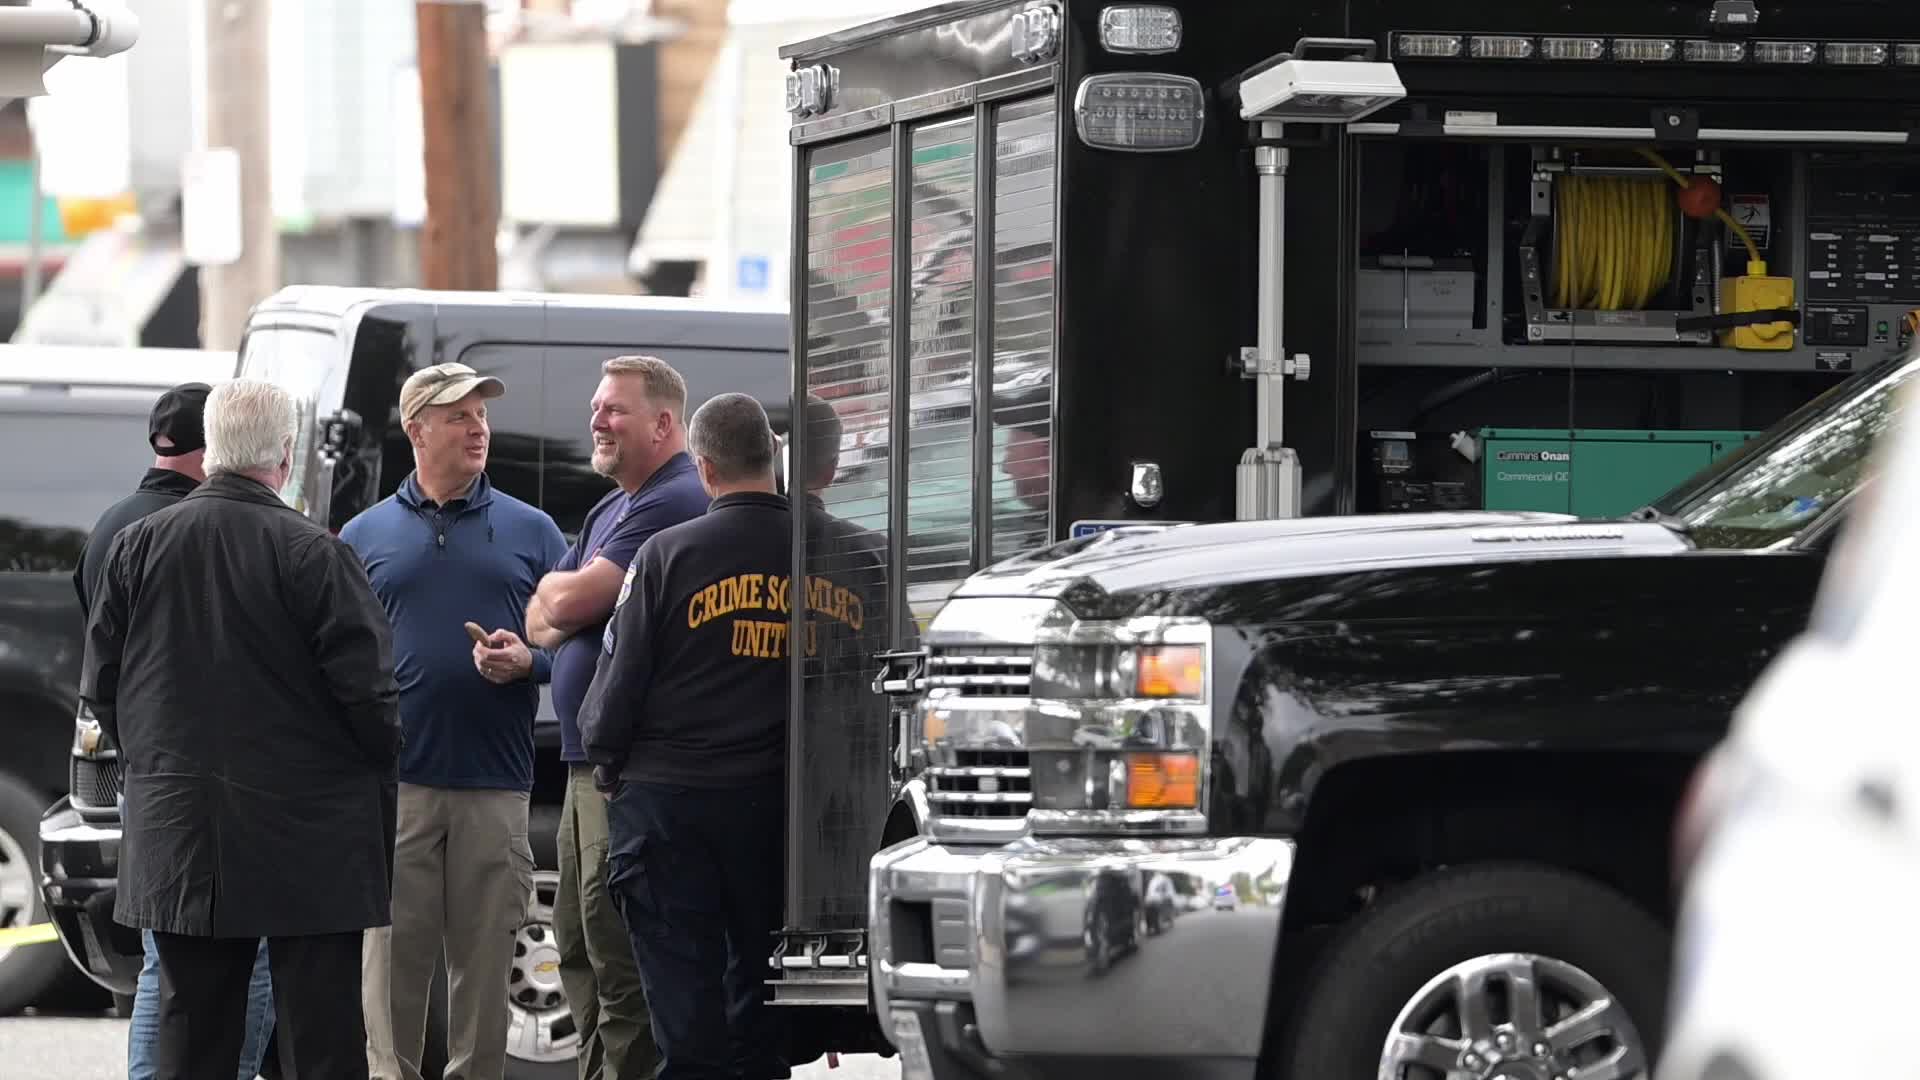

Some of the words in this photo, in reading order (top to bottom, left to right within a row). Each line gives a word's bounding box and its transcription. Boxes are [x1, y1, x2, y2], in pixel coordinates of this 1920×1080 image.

[1497, 451, 1539, 461] Cummins
[1541, 451, 1570, 461] Onan
[1497, 471, 1552, 482] Commercial
[688, 574, 763, 629] CRIME
[731, 619, 787, 658] UNIT
